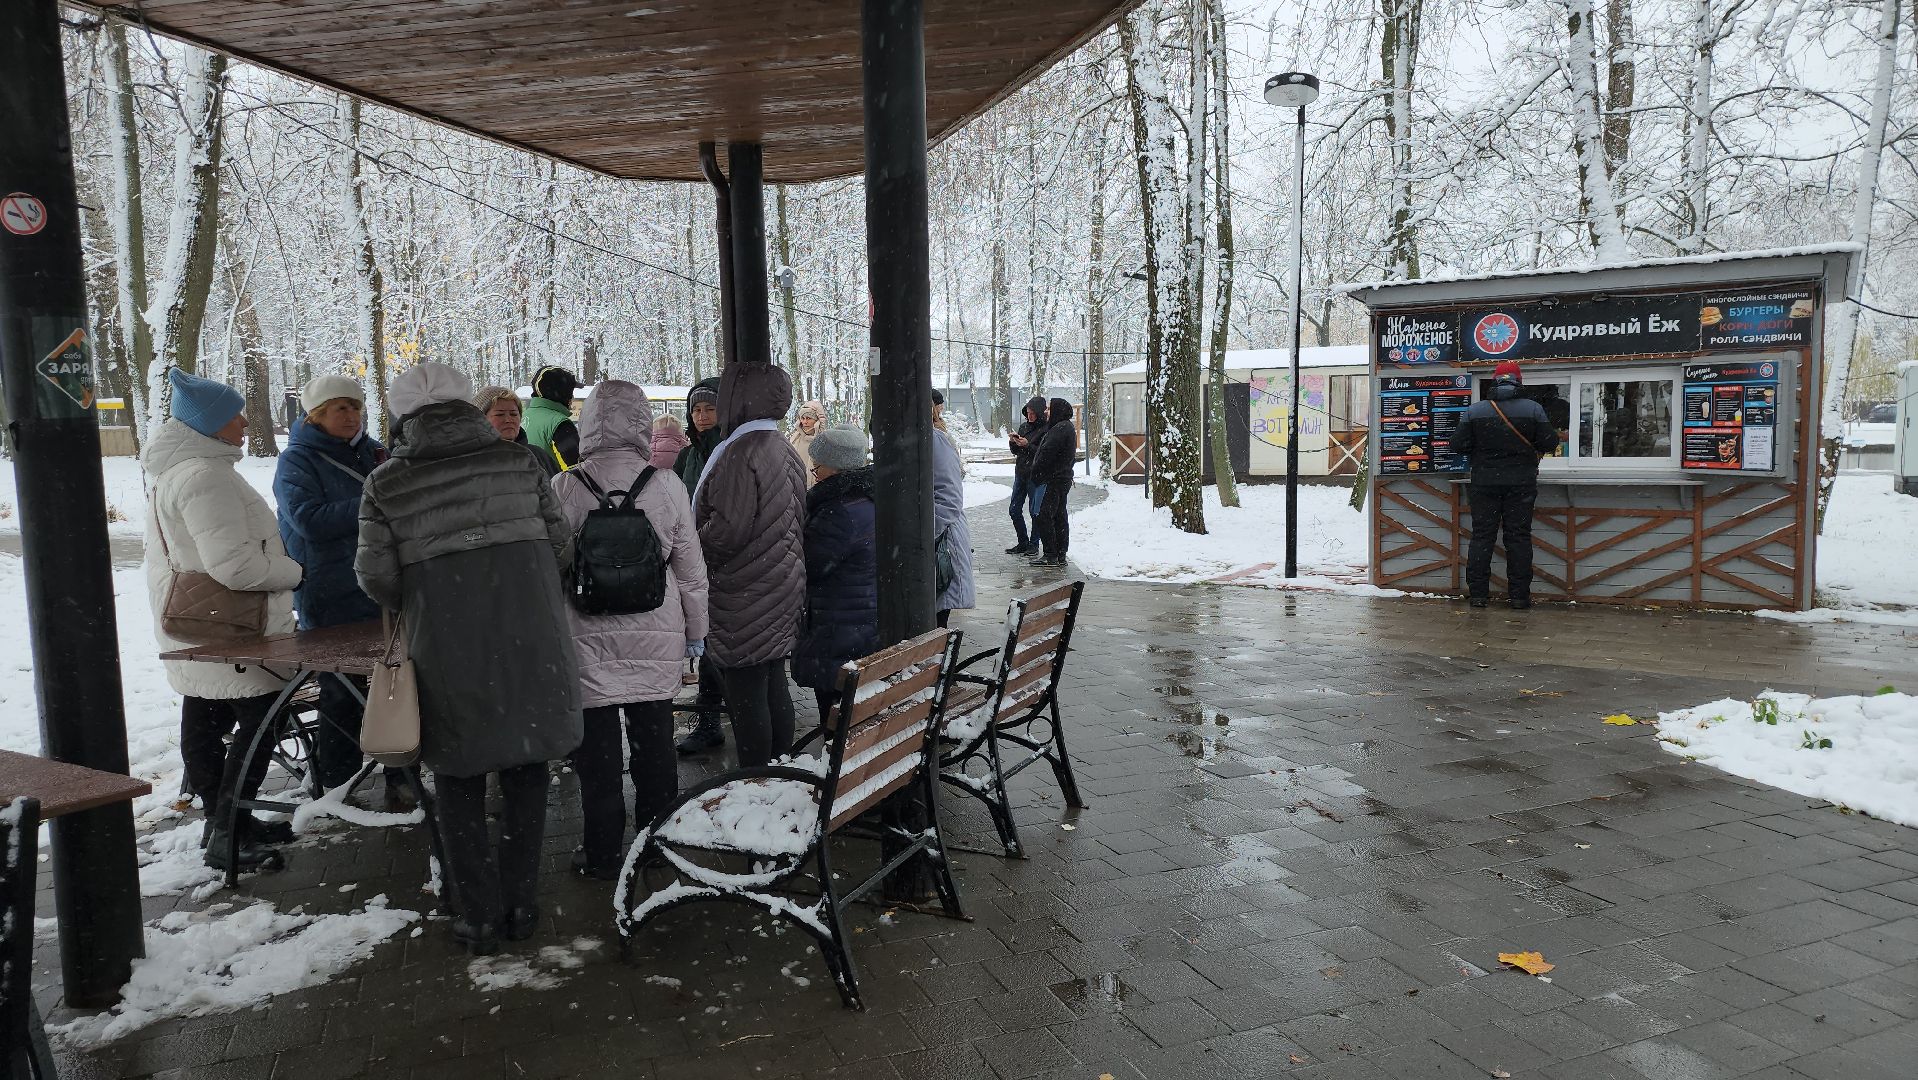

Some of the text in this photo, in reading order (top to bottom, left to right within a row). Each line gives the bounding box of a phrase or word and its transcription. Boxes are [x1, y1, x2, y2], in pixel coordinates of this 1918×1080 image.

[1707, 292, 1808, 304] МНОГОСЛОЙНЫЕ СЭНДВИЧИ
[1729, 305, 1784, 317] БУРГЕРЫ
[1387, 316, 1448, 335] Жареное
[1529, 313, 1681, 342] Кудрявый Ёж
[1381, 331, 1453, 347] МОРОЖЕНОЕ
[1710, 333, 1802, 345] РОЛЛ-СЭНДВИЧИ
[1252, 417, 1323, 435] ВОТ ЛИН
